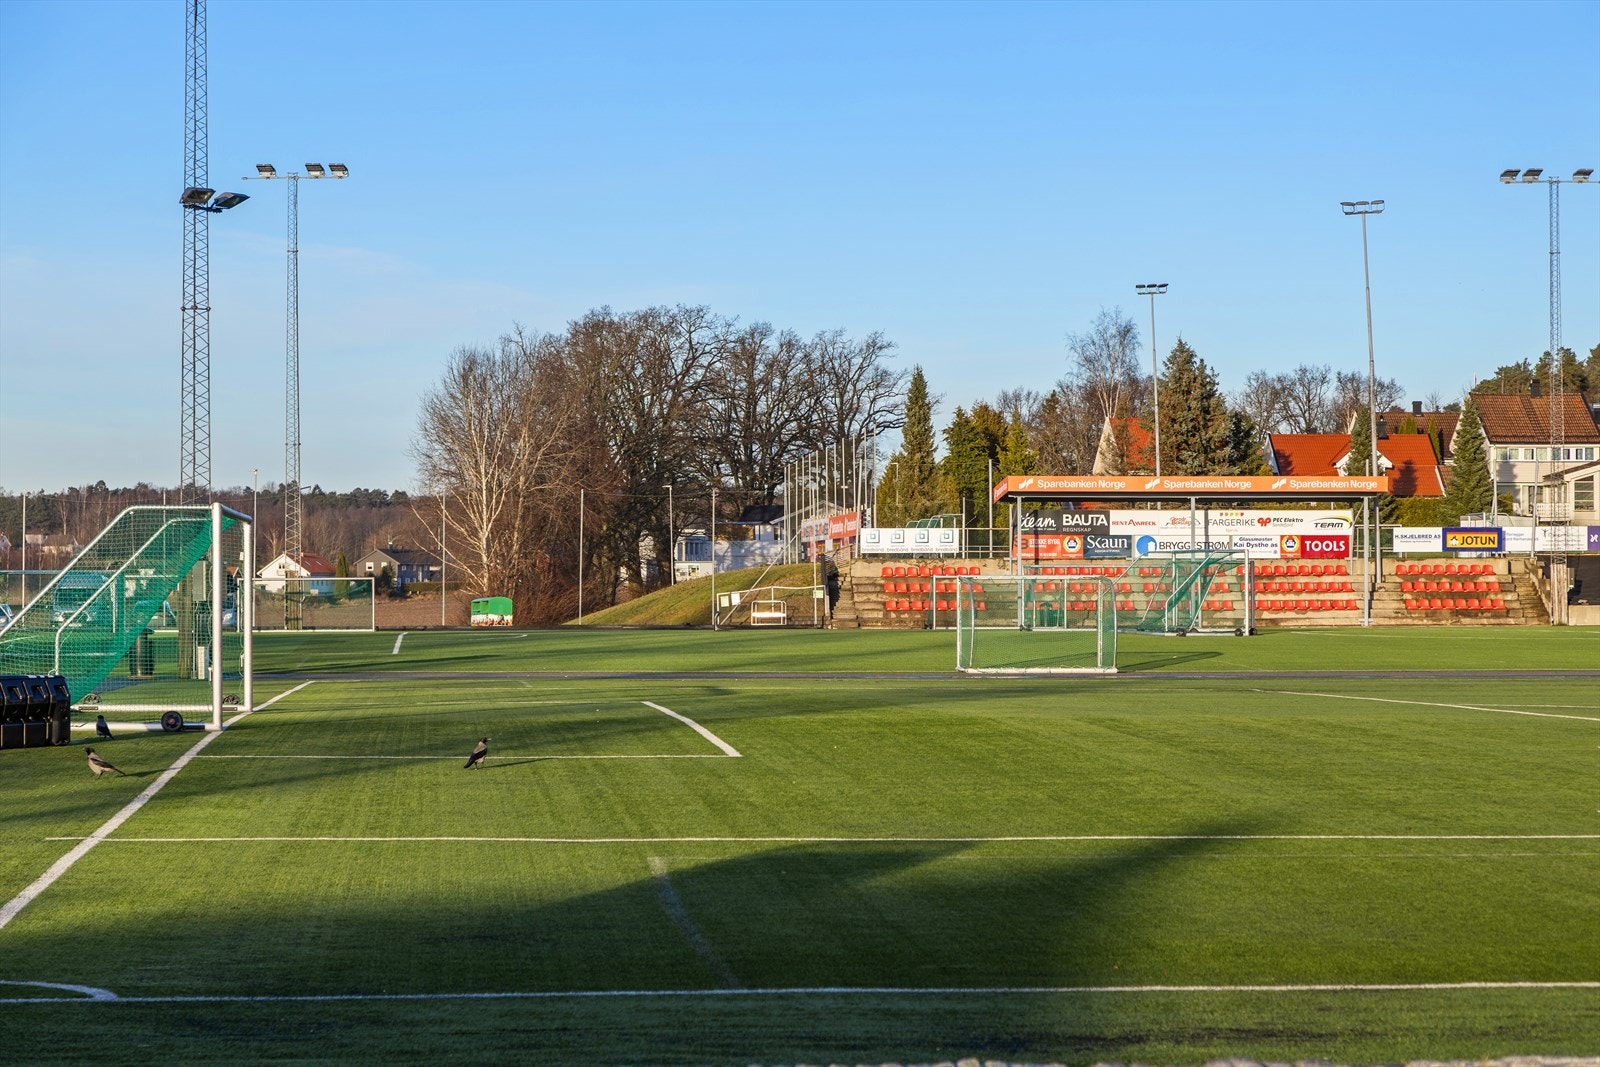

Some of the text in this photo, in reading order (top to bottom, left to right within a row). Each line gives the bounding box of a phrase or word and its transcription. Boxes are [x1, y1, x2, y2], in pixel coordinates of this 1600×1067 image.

[1037, 479, 1126, 490] Sparebanken Norge
[1163, 479, 1252, 490] Sparebanken Norge
[1289, 479, 1378, 490] Sparebanken Norge
[1062, 514, 1109, 526] BAUTA
[1208, 518, 1256, 527] FARGERIKE
[1086, 535, 1128, 549] Skaun
[1158, 541, 1230, 550] BRYGGSTRØM
[1304, 540, 1346, 552] TOOLS
[1460, 536, 1496, 546] JOTUN
